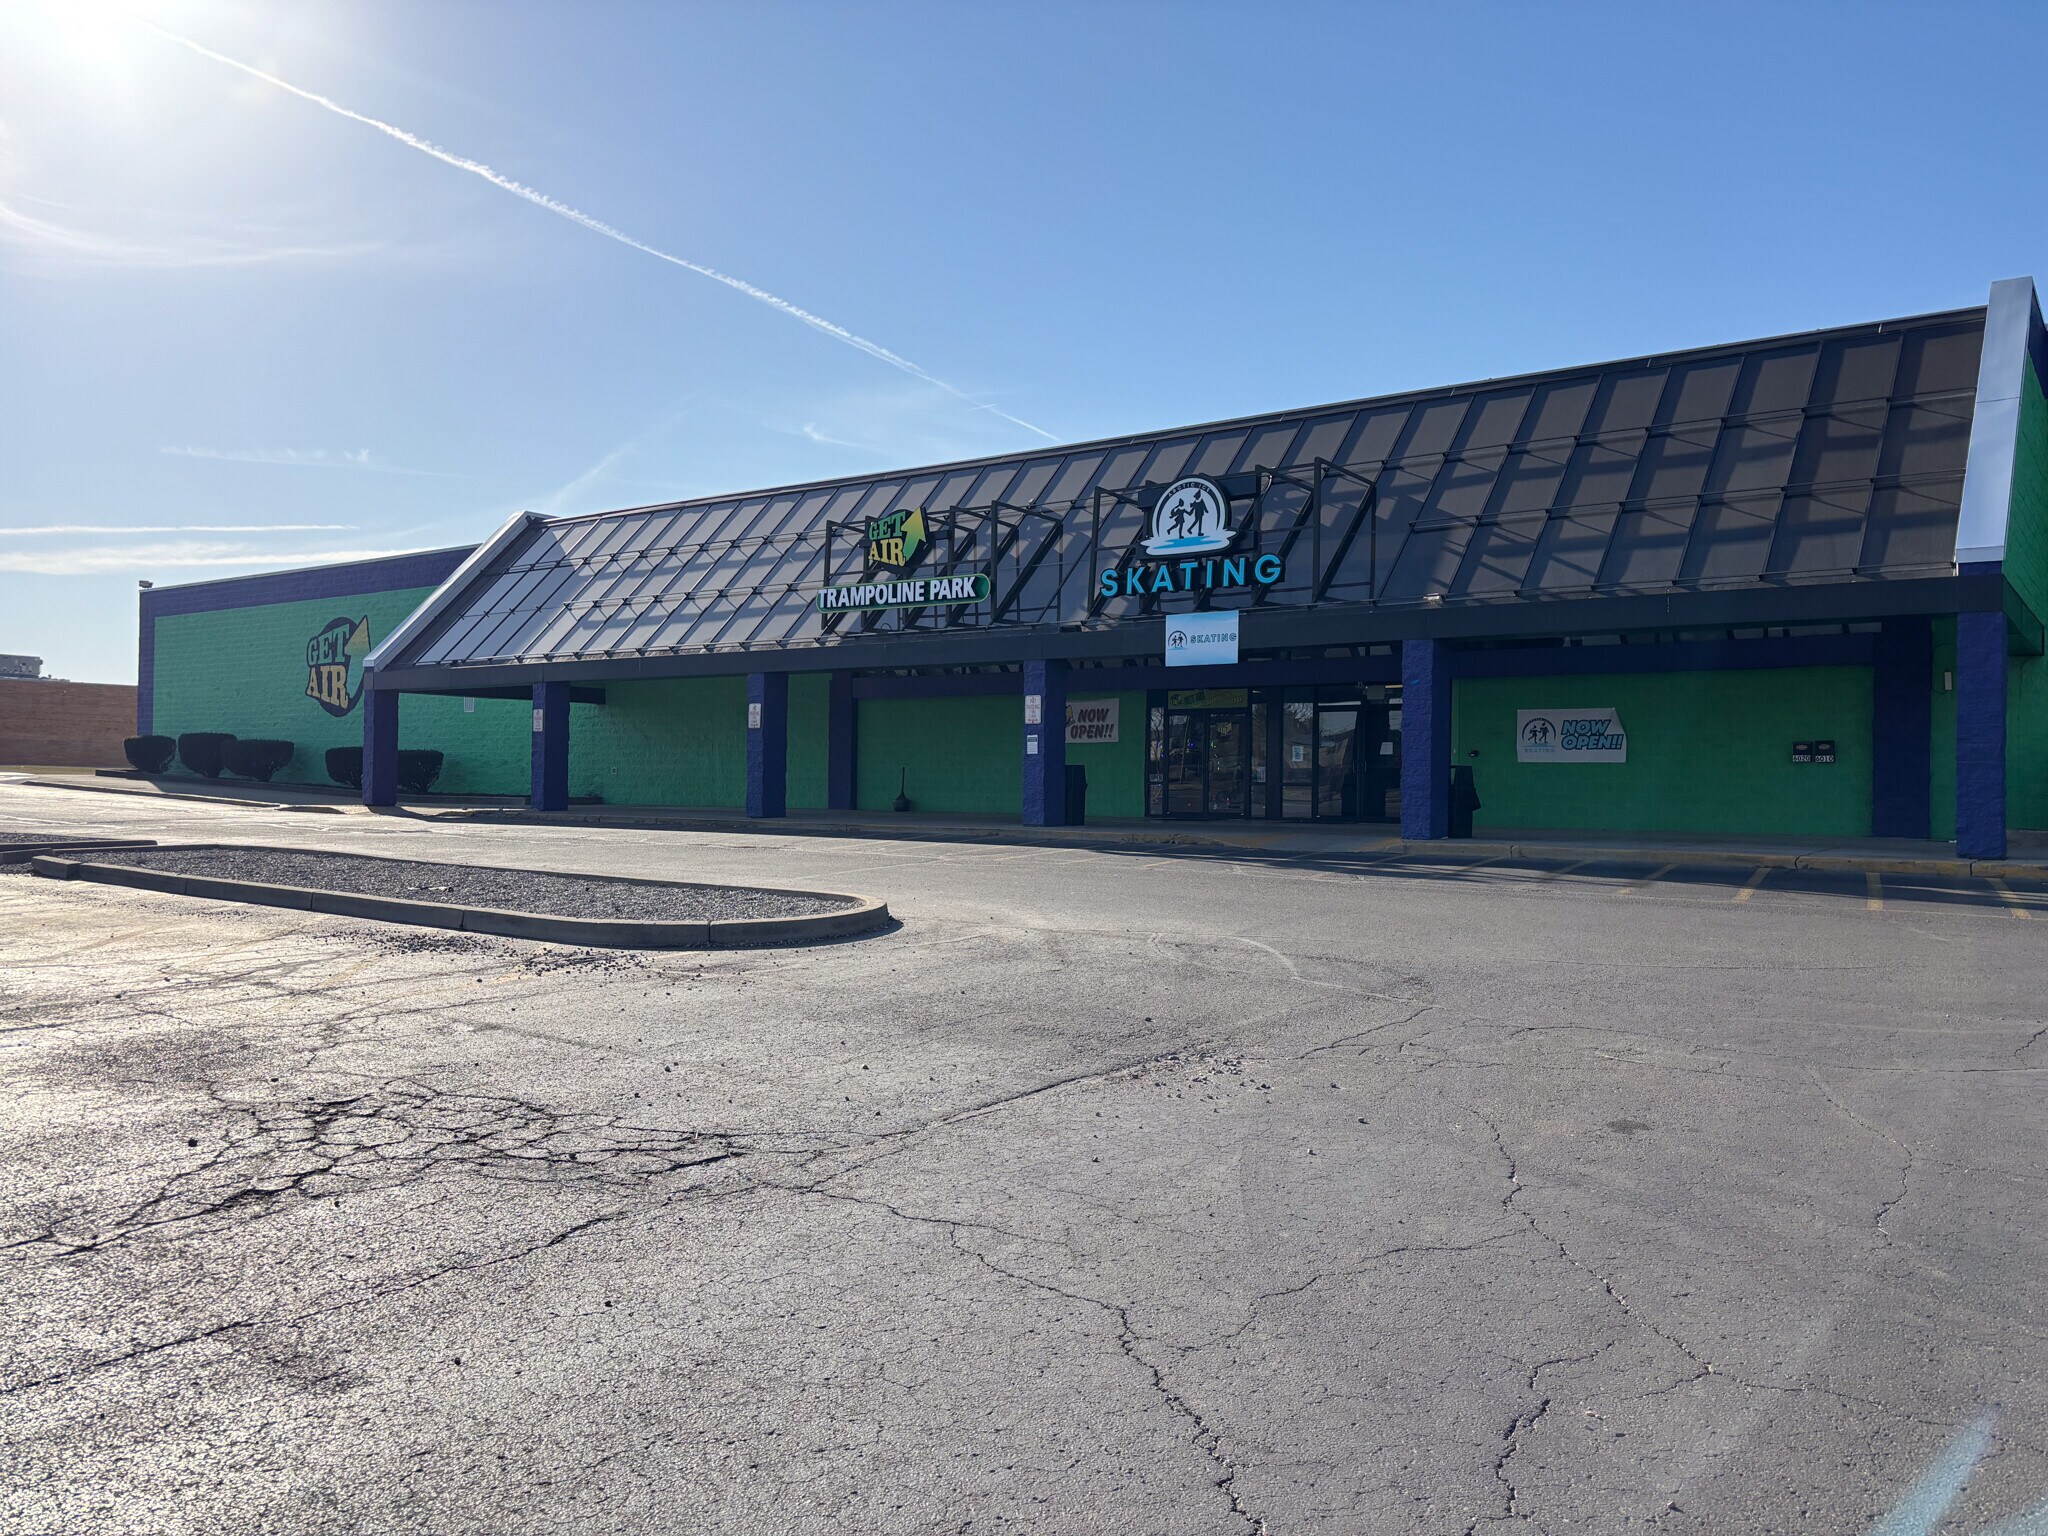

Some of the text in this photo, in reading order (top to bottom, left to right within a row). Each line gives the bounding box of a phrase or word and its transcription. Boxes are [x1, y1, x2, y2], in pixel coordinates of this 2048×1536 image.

[1168, 482, 1211, 497] ARCTIC ICE
[868, 511, 906, 541] GET
[868, 538, 906, 567] AIR
[1100, 554, 1281, 597] SKATING
[818, 576, 976, 608] TRAMPOLINE PARK
[307, 623, 350, 666] GET
[1190, 633, 1237, 644] SKATING
[306, 665, 349, 709] AIR
[1077, 708, 1109, 723] NOW
[1560, 719, 1611, 735] NOW
[1070, 723, 1115, 740] OPEN!!
[1561, 733, 1624, 750] OPEN!!
